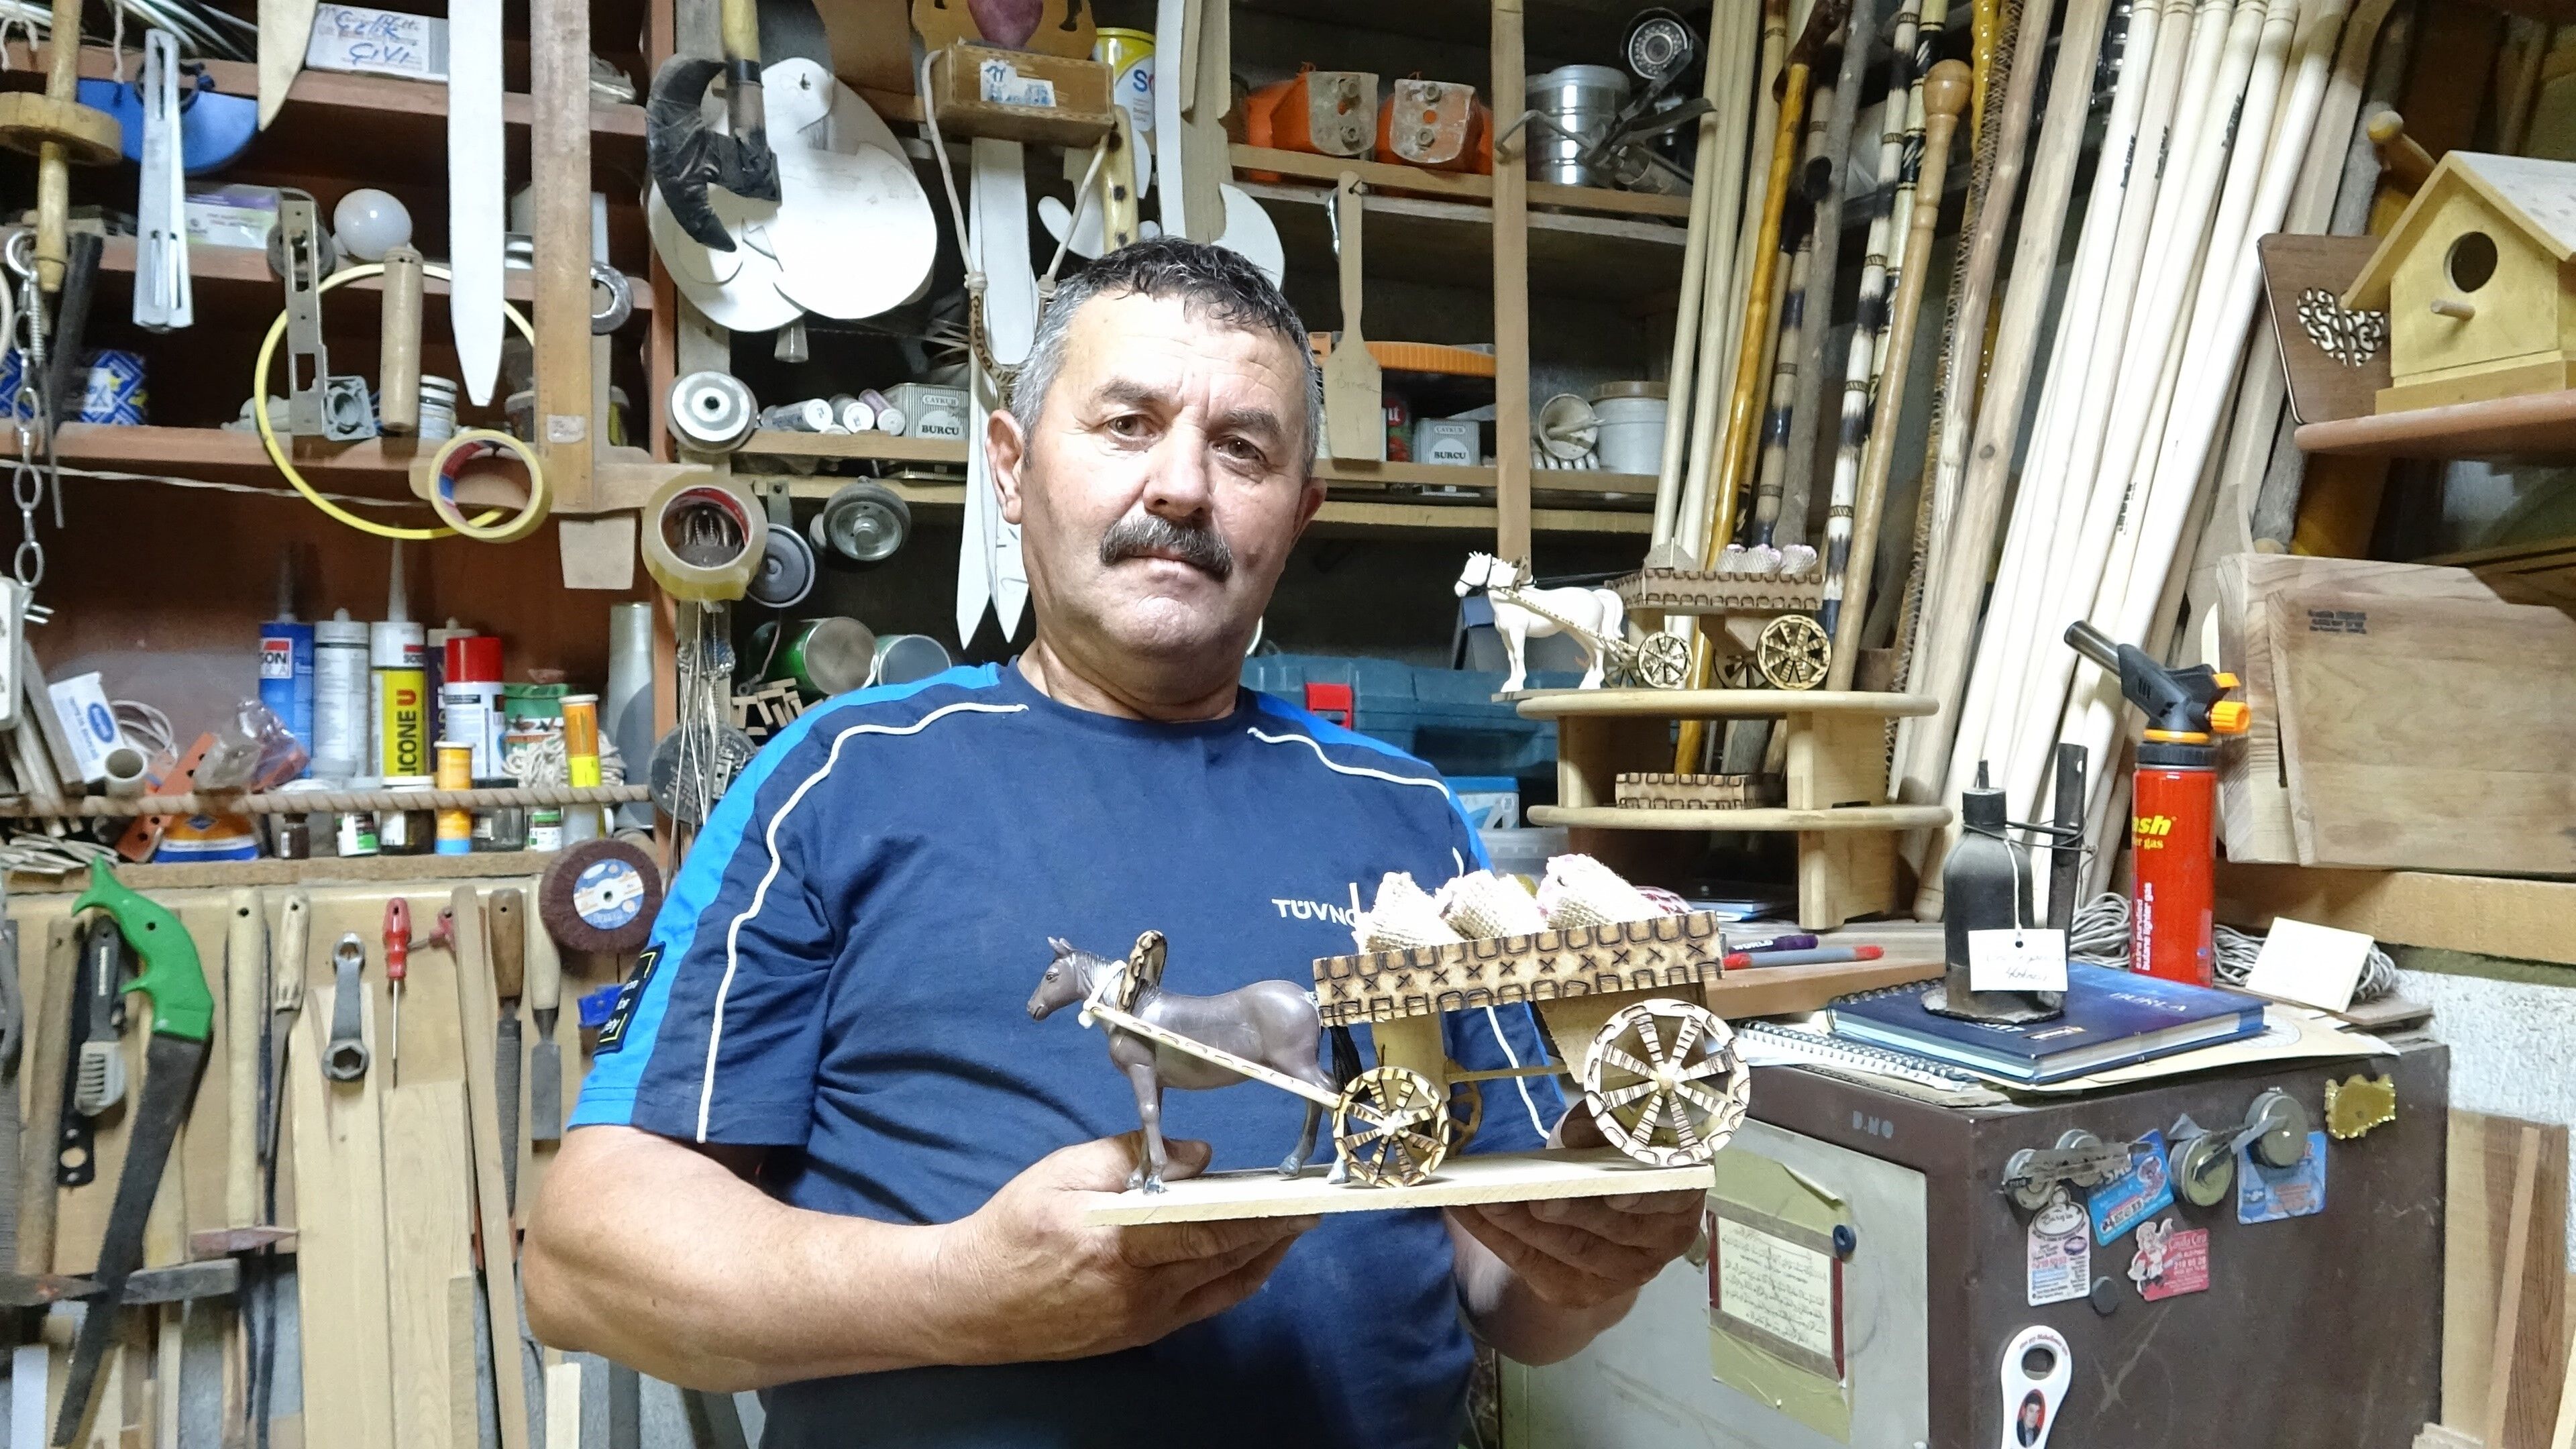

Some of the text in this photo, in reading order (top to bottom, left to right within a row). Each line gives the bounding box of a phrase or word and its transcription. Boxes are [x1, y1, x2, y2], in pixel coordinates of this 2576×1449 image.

[922, 425, 960, 436] BURCU
[1434, 451, 1467, 460] BURCU
[396, 688, 417, 776] ICONE U
[2143, 838, 2164, 850] gas
[2141, 882, 2154, 971] butane lighter gas
[1732, 938, 1774, 951] WORLD
